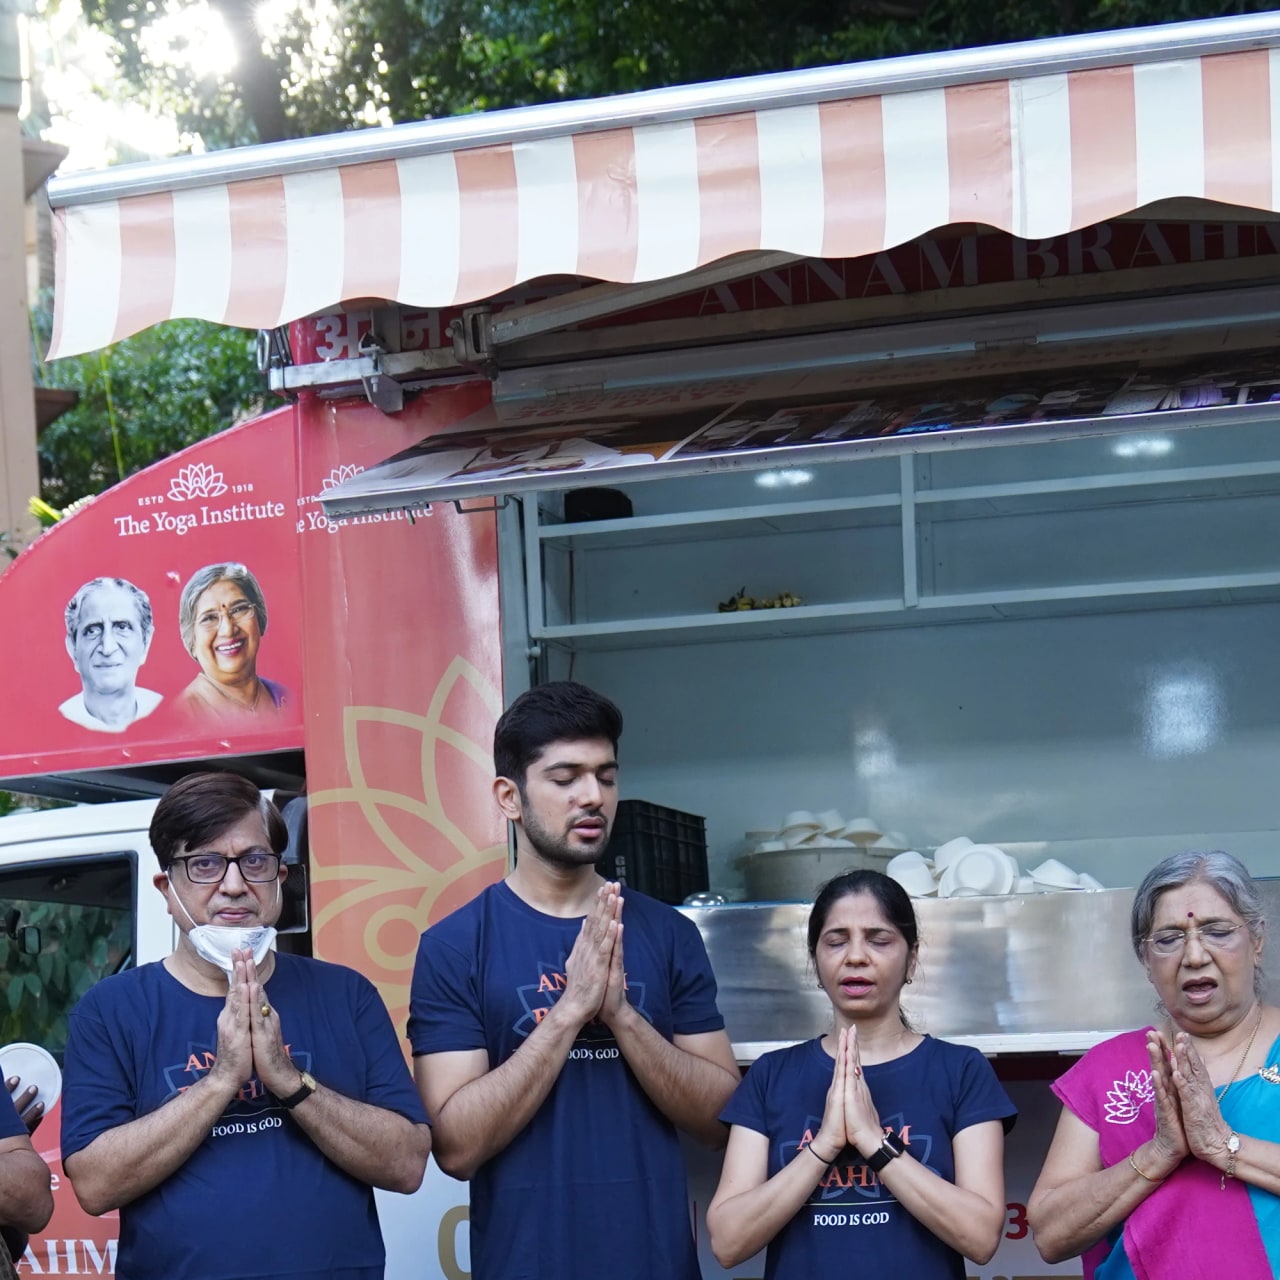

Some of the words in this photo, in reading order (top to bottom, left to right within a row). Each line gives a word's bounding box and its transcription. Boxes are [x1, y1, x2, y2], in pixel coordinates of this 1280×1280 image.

[138, 495, 164, 506] ESTD
[231, 483, 254, 494] 1918
[114, 514, 150, 536] The
[152, 510, 197, 536] Yoga
[200, 500, 285, 524] Institute
[212, 1123, 245, 1137] FOOD
[246, 1121, 257, 1133] IS
[258, 1116, 282, 1131] GOD
[813, 1214, 846, 1226] FOOD
[848, 1214, 860, 1226] IS
[861, 1212, 890, 1225] GOD
